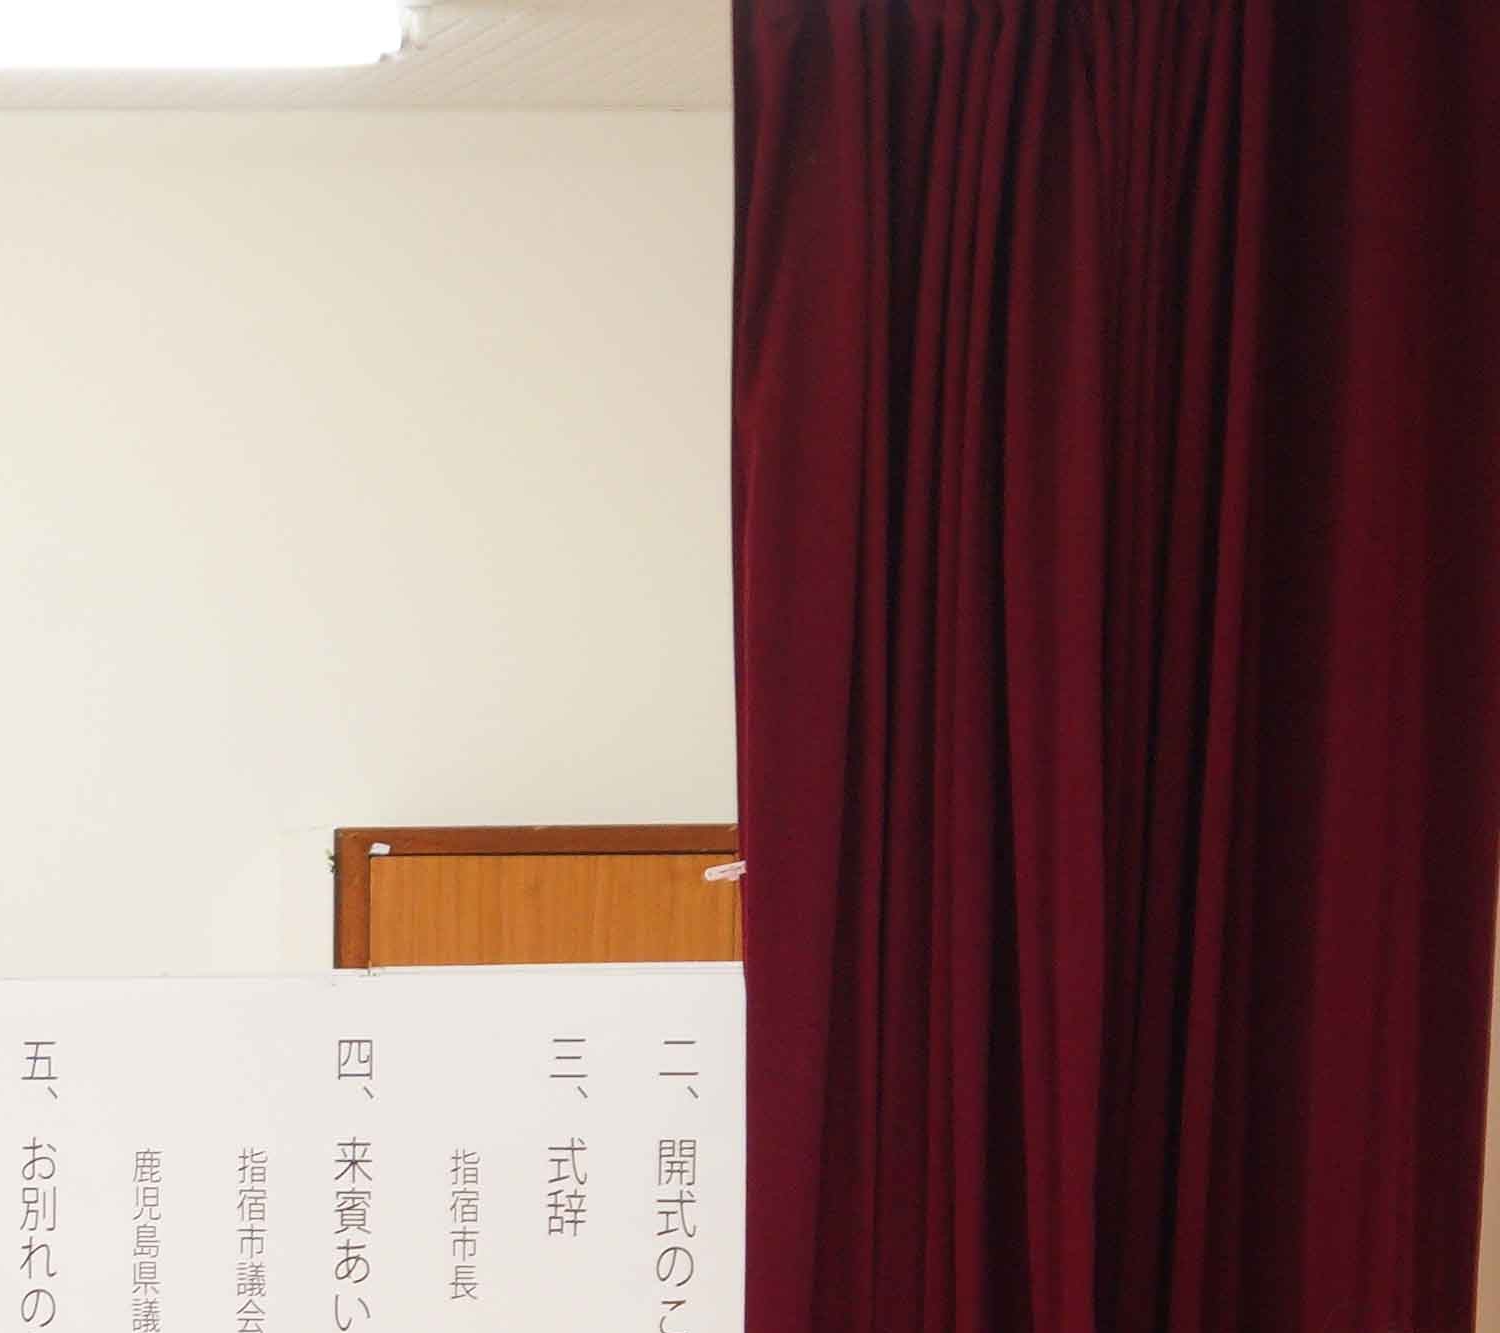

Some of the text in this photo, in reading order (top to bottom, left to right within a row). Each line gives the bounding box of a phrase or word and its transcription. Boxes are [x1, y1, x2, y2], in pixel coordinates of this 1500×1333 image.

[448, 1147, 483, 1301] 指宿市長
[546, 1036, 590, 1238] 三、式辞
